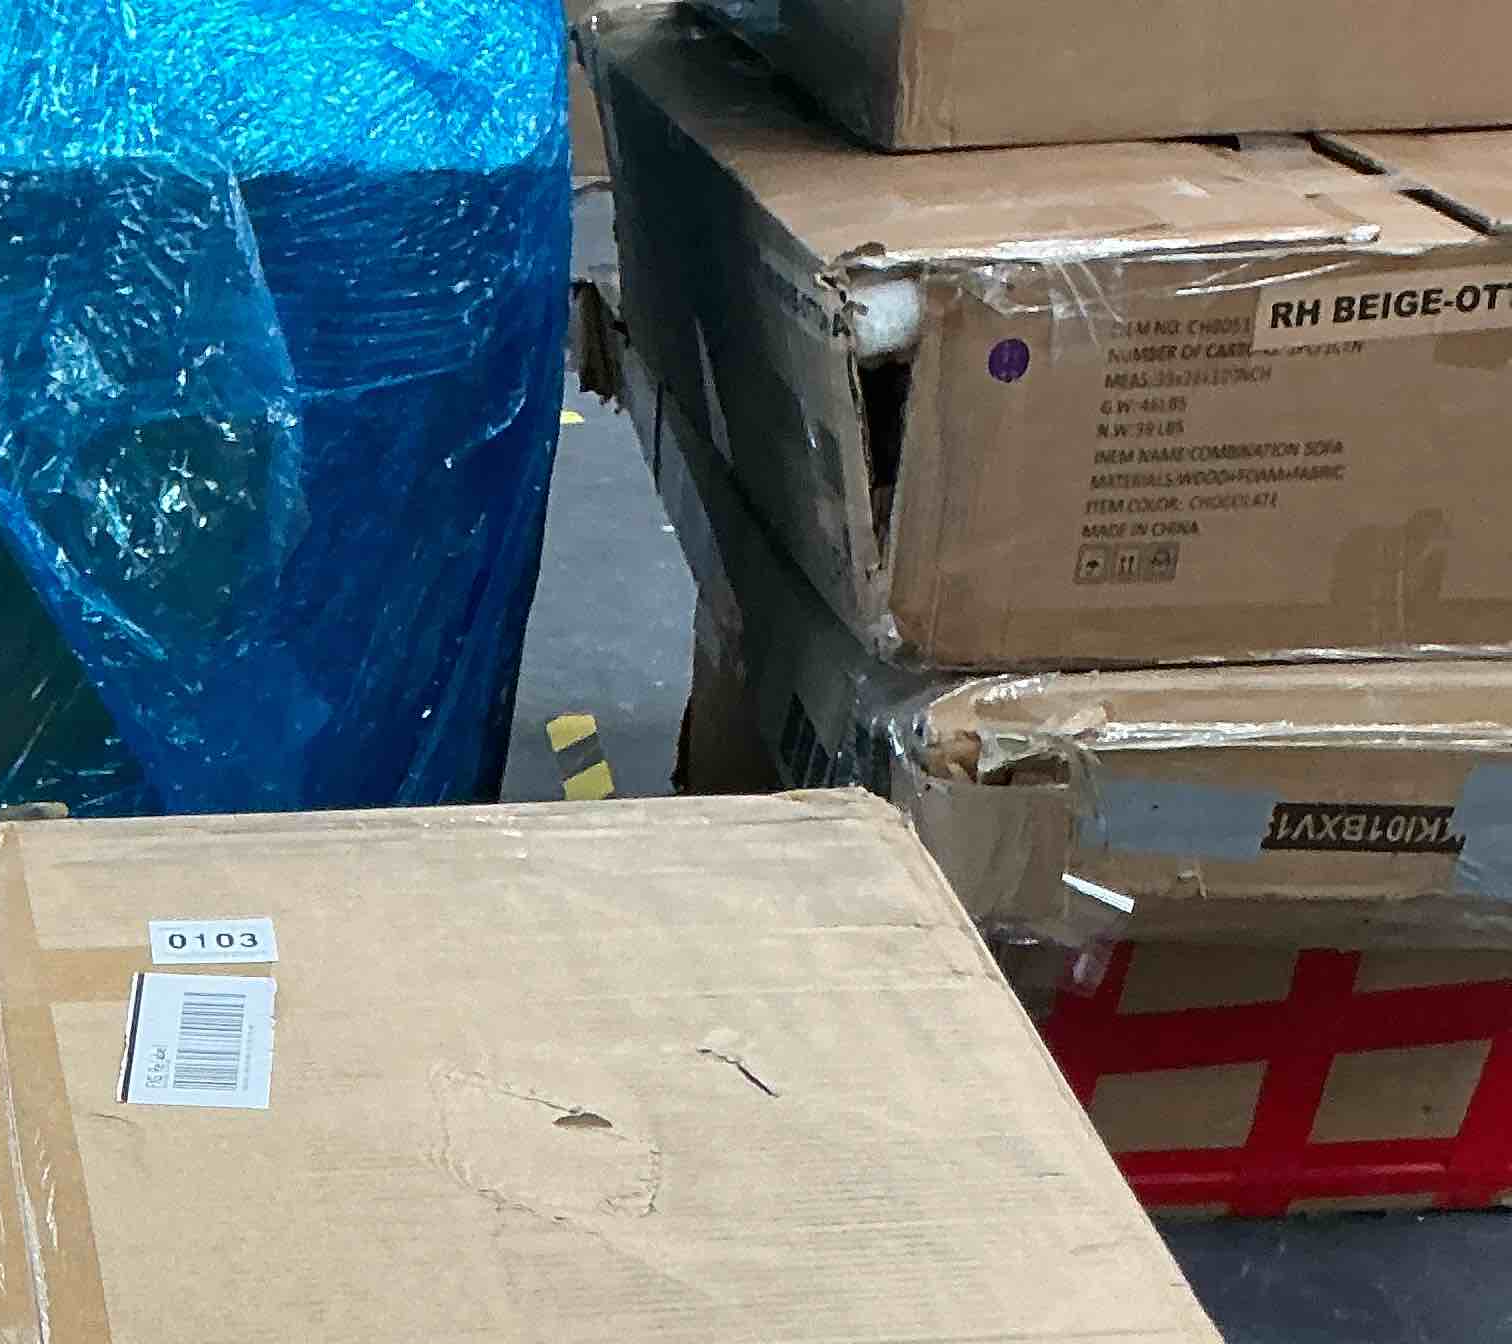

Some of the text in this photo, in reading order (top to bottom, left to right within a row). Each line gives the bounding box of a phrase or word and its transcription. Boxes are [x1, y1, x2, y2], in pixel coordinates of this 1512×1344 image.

[1271, 299, 1321, 329] RH
[1081, 522, 1128, 538] MADE
[1150, 519, 1201, 538] CHINA
[167, 931, 260, 950] 0103
